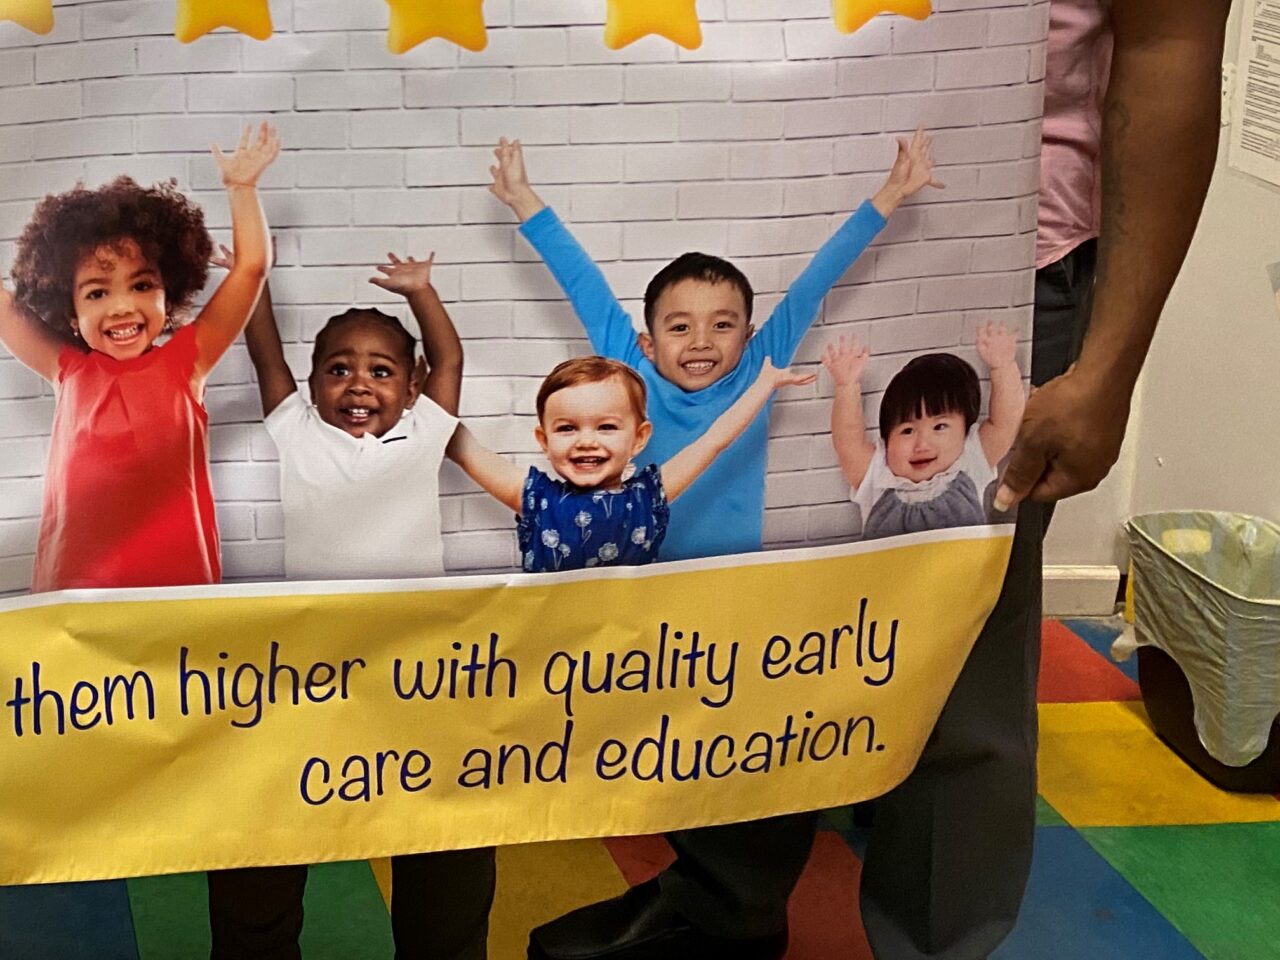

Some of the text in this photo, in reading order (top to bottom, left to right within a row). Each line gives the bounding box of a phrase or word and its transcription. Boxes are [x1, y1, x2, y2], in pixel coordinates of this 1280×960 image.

[7, 661, 156, 740] them
[176, 642, 366, 730] higher
[391, 632, 518, 702] with
[544, 624, 739, 718] quality
[760, 598, 899, 692] early
[299, 708, 887, 808] care and education.
